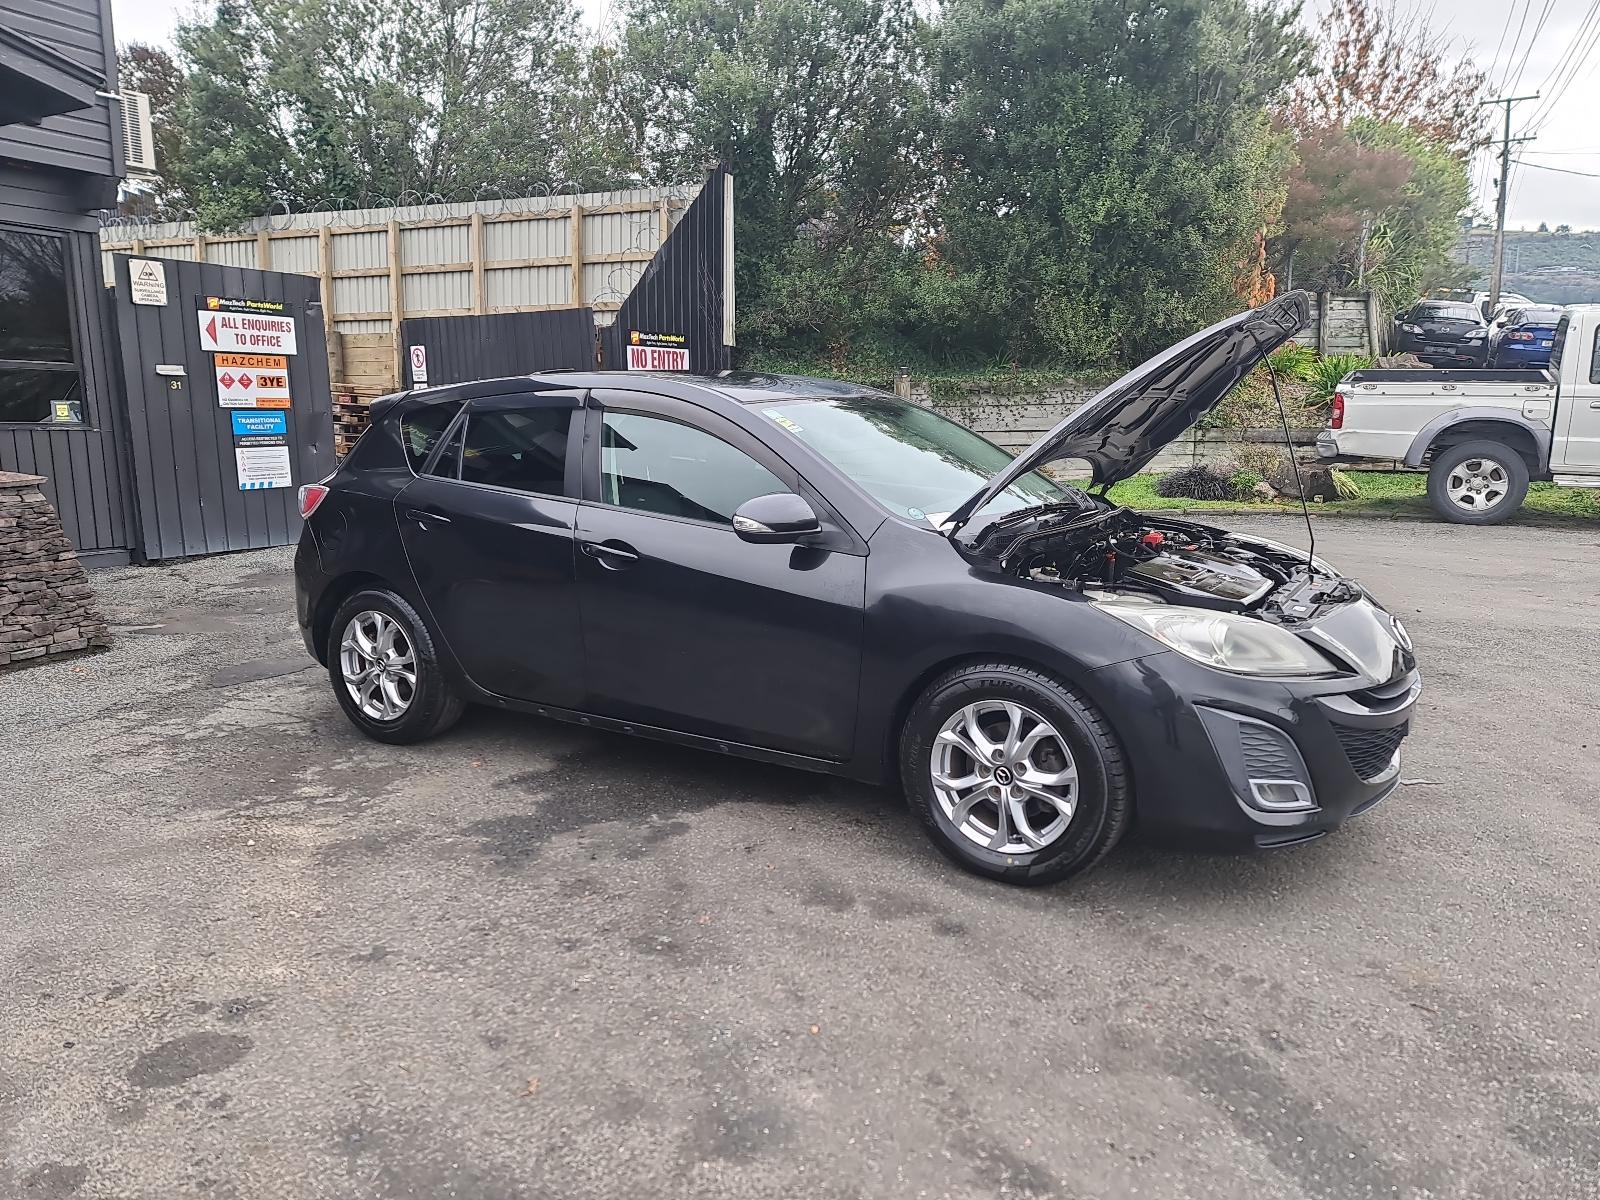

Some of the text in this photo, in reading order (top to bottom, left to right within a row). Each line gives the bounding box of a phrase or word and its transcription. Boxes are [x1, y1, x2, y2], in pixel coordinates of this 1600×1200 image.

[133, 280, 165, 289] WARNING
[219, 298, 246, 307] MazTech
[246, 300, 283, 310] PartsWorld
[221, 316, 292, 333] ALL ENQUIRIES
[234, 333, 282, 348] TO OFFICE
[659, 334, 685, 343] PartsWorld
[221, 355, 281, 367] HAZCHEM
[631, 348, 686, 370] NO ENTRY
[170, 380, 182, 390] 31
[260, 376, 284, 387] 3YE
